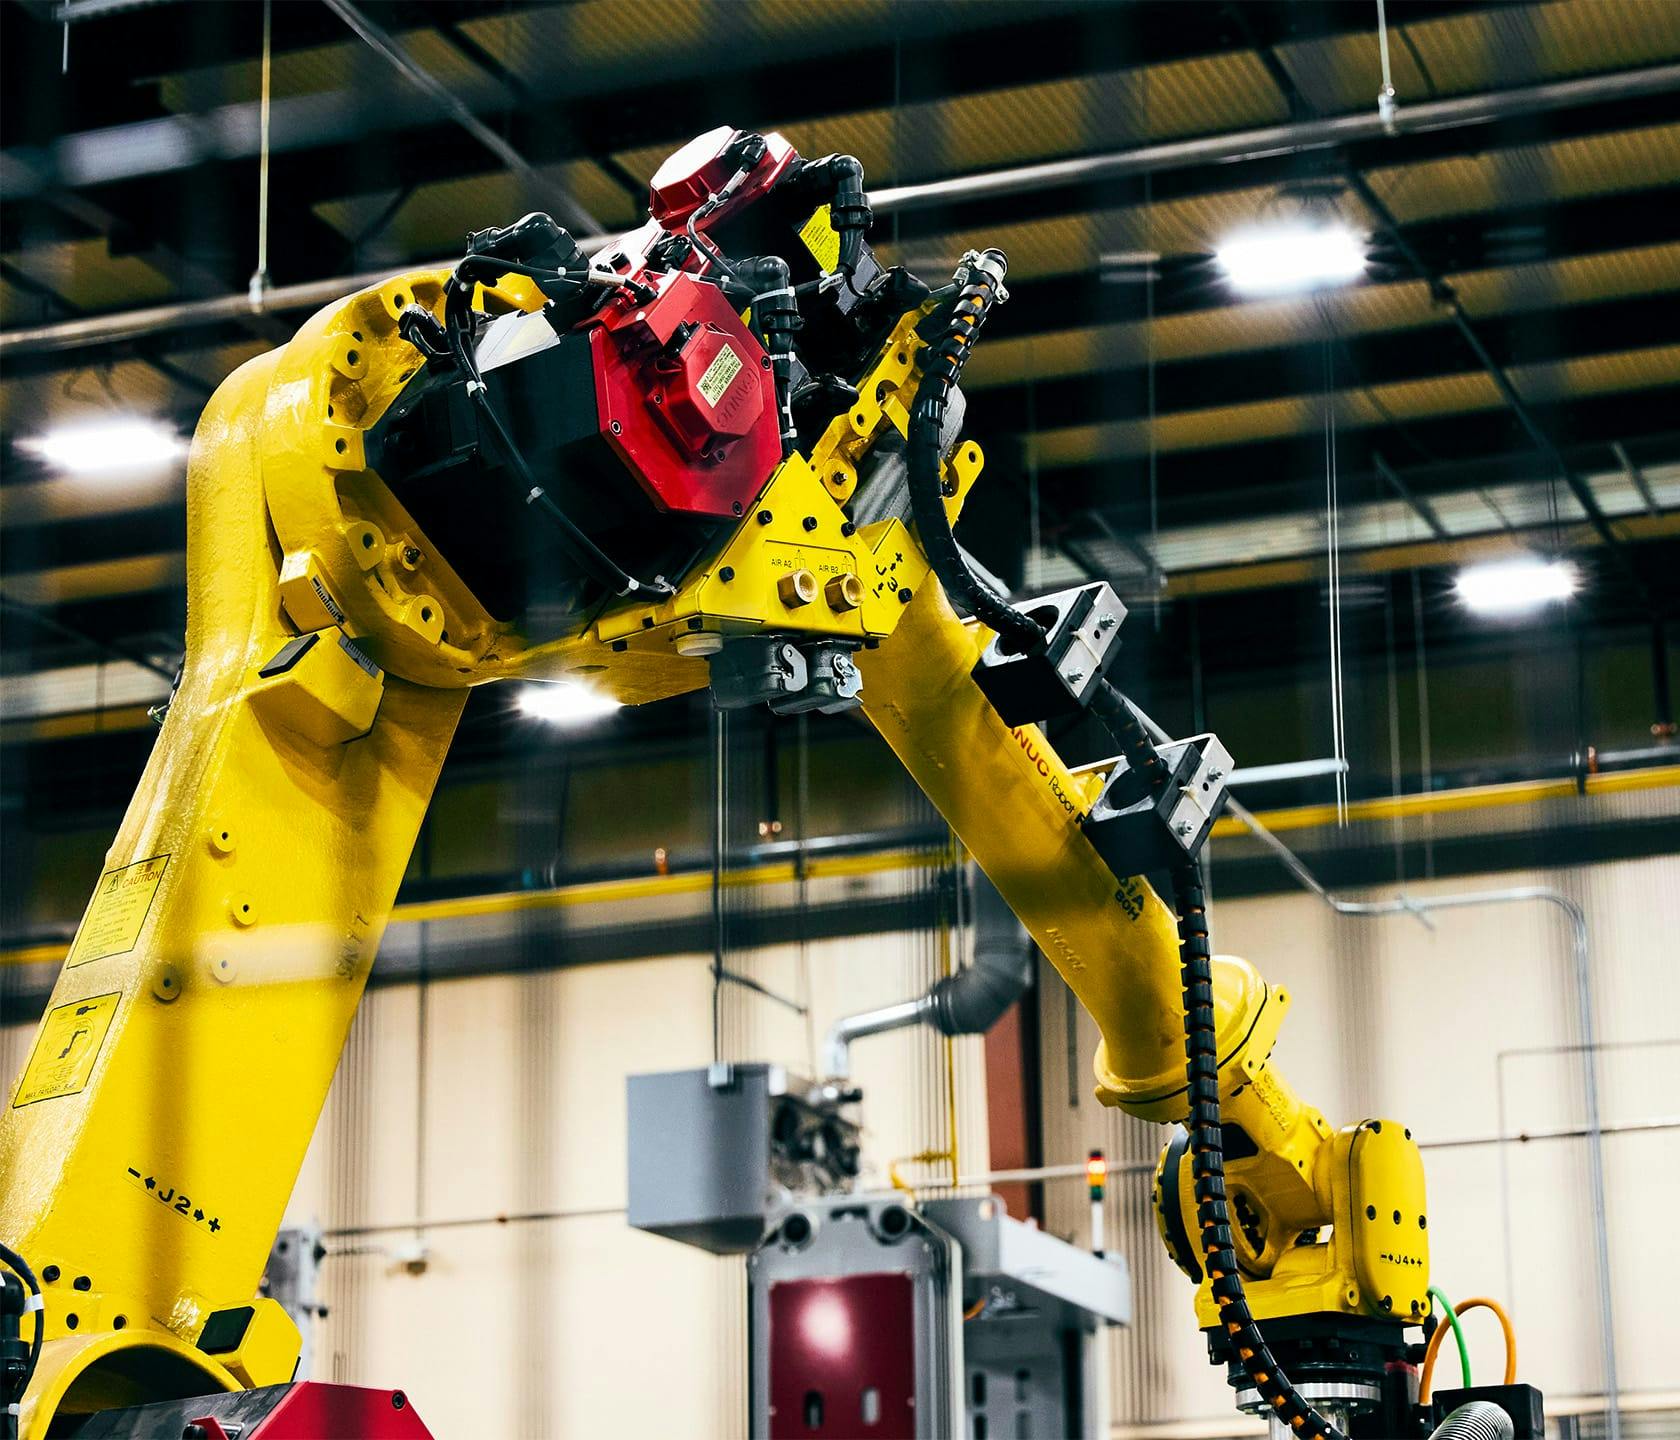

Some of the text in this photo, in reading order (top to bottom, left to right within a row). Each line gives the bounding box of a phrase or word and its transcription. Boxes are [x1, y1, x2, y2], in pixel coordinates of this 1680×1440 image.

[771, 558, 793, 568] AIR A2
[818, 564, 829, 573] AIR
[1048, 775, 1075, 814] Robot
[121, 871, 161, 889] CAUTION
[158, 1188, 192, 1216] J2
[1395, 1254, 1409, 1265] J4
